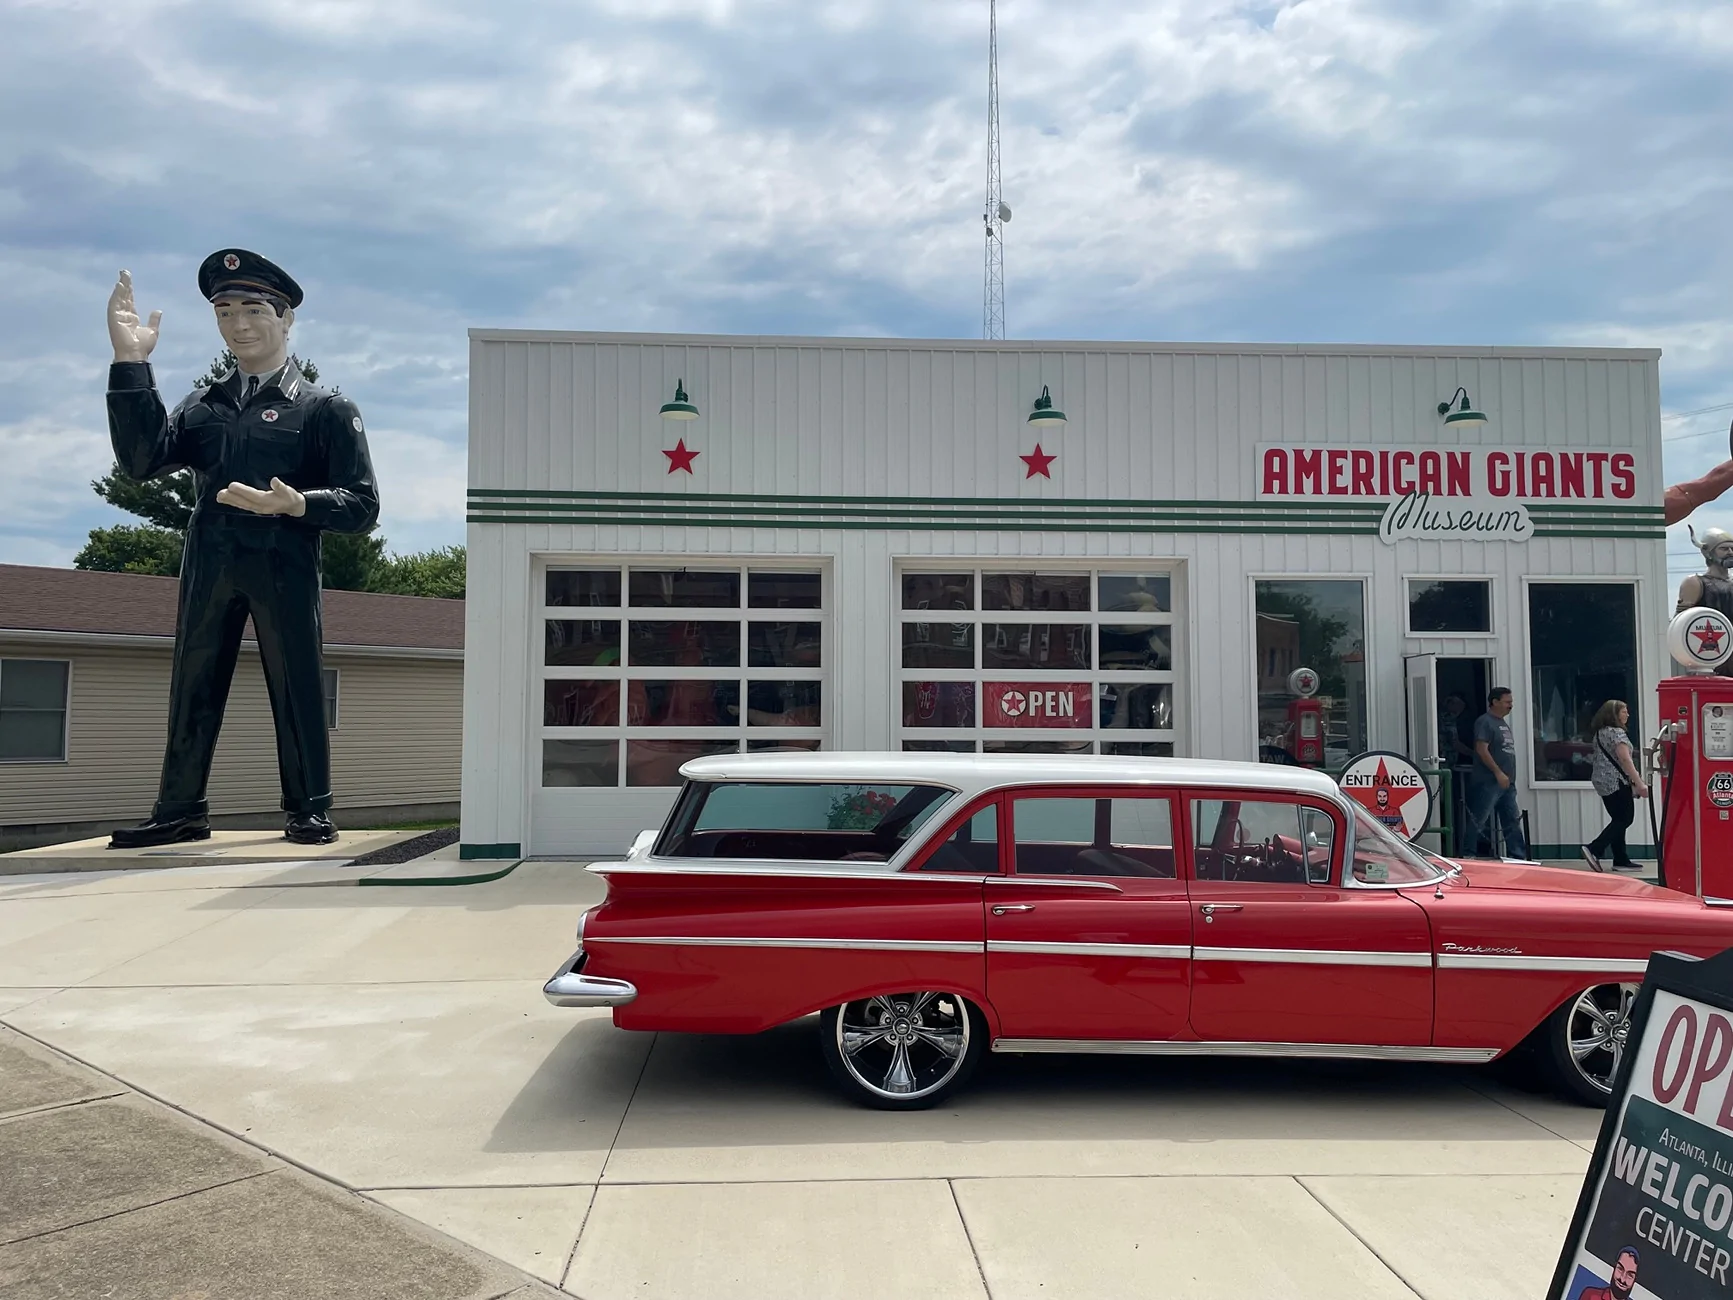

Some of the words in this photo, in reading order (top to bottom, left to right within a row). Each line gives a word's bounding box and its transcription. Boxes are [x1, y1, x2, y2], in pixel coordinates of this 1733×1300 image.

[1261, 448, 1472, 497] AMERICAN
[1486, 451, 1636, 500] GIANTS
[1386, 490, 1526, 536] Museum
[1000, 690, 1074, 717] OPEN
[1345, 774, 1418, 786] ENTRANCE
[1717, 779, 1730, 789] 66
[1442, 942, 1522, 954] Parkwood
[1652, 1004, 1733, 1132] OP
[1614, 1136, 1733, 1241] WELCO
[1635, 1206, 1731, 1287] CENTER
